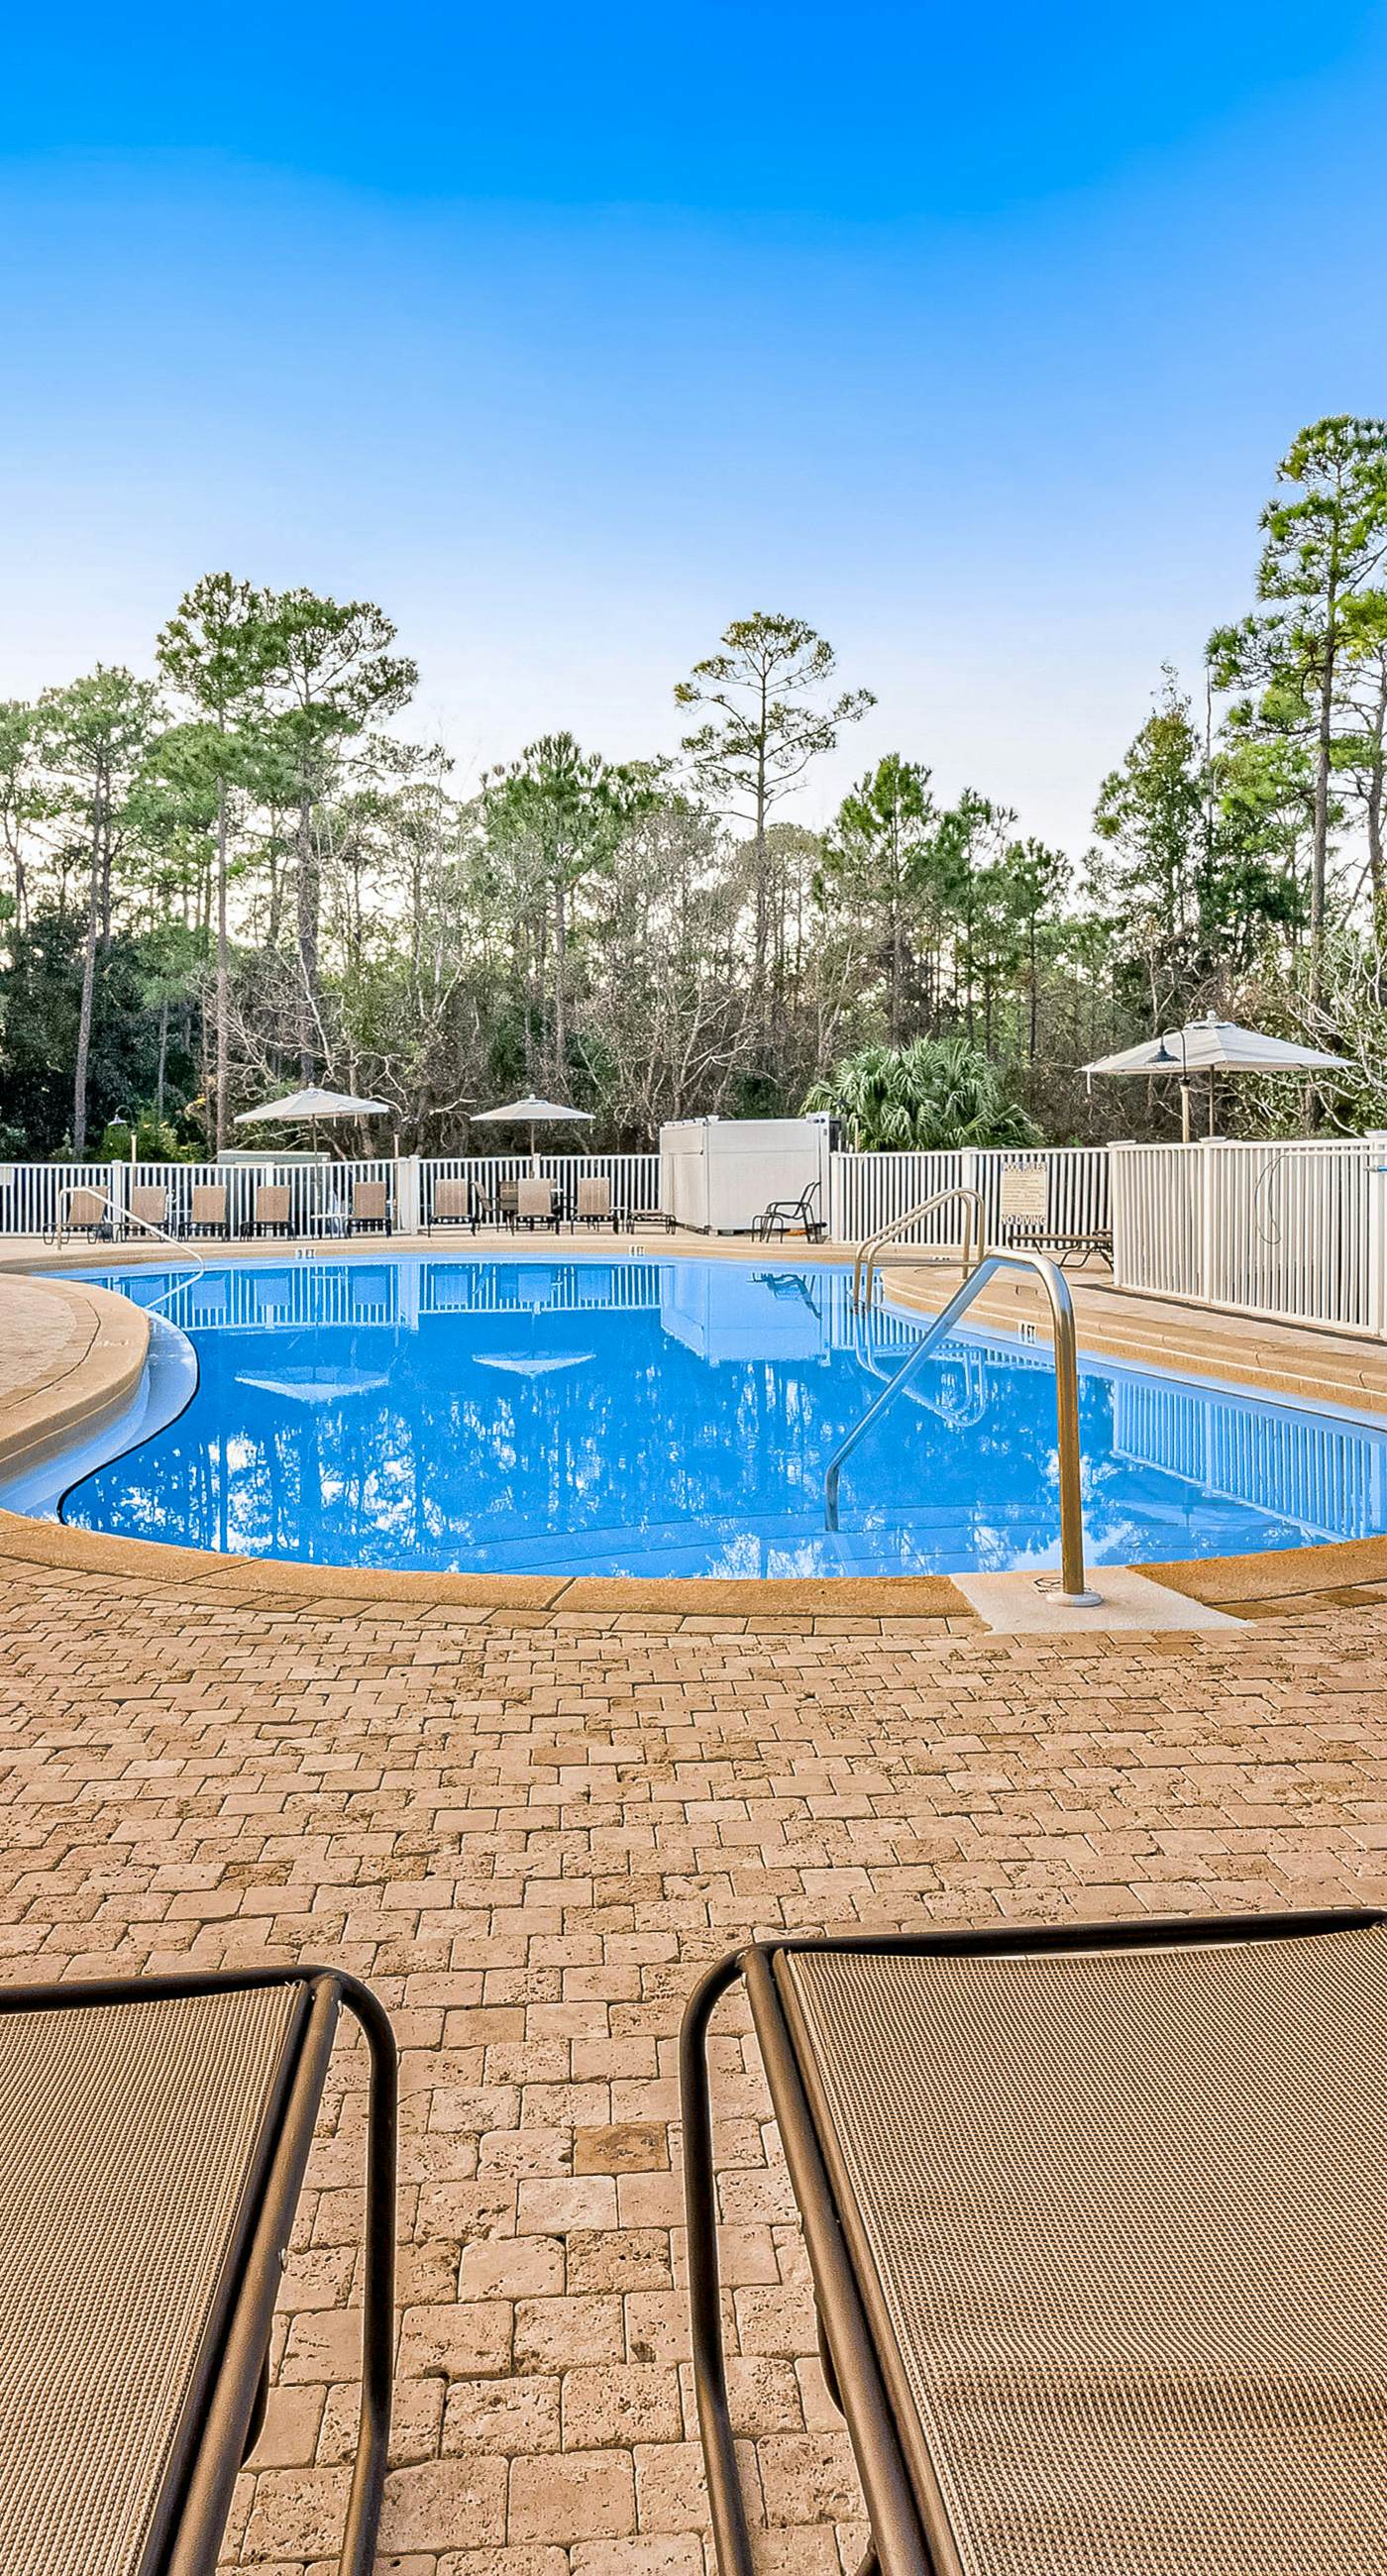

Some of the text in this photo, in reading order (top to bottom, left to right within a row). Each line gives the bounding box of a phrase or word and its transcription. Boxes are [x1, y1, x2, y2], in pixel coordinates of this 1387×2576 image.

[1002, 1162, 1048, 1173] POOL RULES
[1000, 1214, 1047, 1226] NO DIVING
[1026, 1324, 1035, 1345] FT
